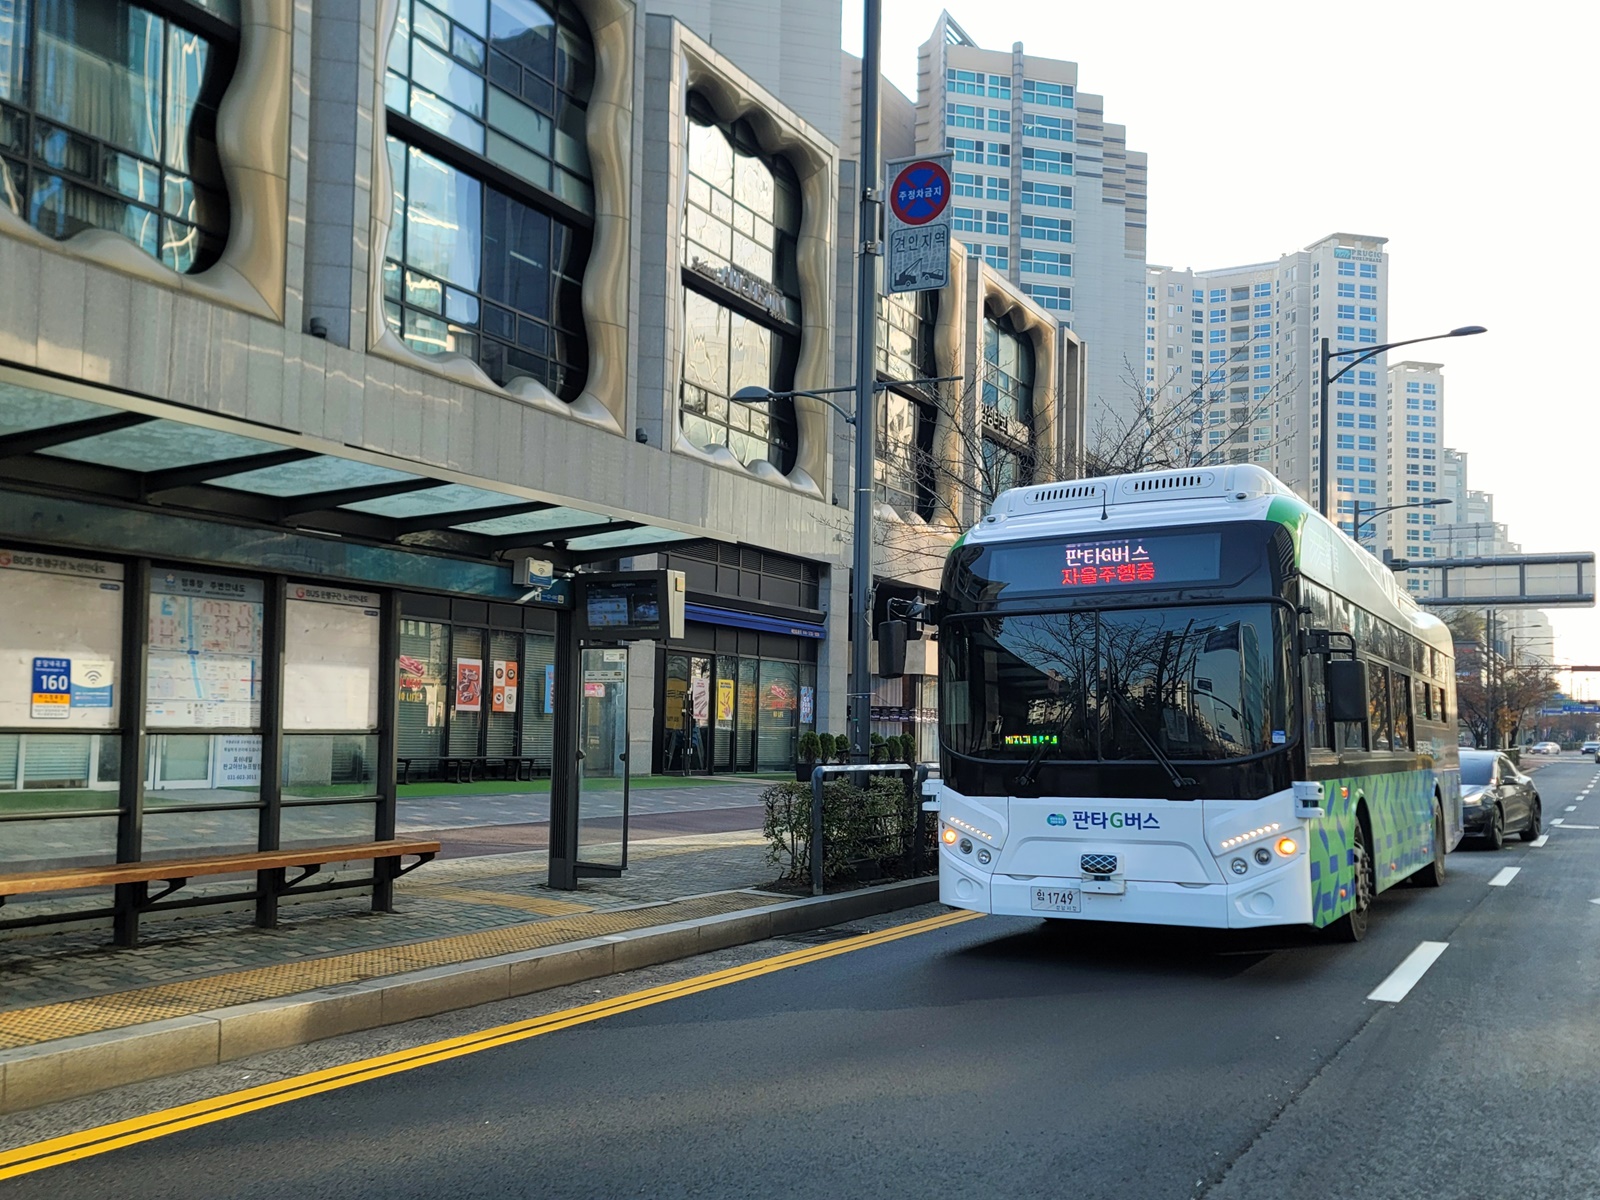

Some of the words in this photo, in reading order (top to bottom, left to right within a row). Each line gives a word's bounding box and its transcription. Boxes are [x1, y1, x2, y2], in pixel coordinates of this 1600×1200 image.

[898, 186, 942, 202] 주정차금지
[894, 231, 946, 253] 견인지역
[1352, 250, 1382, 258] PRUGIO
[1065, 545, 1150, 567] 판타G버스
[1061, 562, 1155, 585] 자율주행중
[40, 675, 68, 690] 160
[1072, 811, 1160, 830] 판타G버스
[1036, 890, 1045, 901] 임
[1047, 891, 1074, 905] 1749
